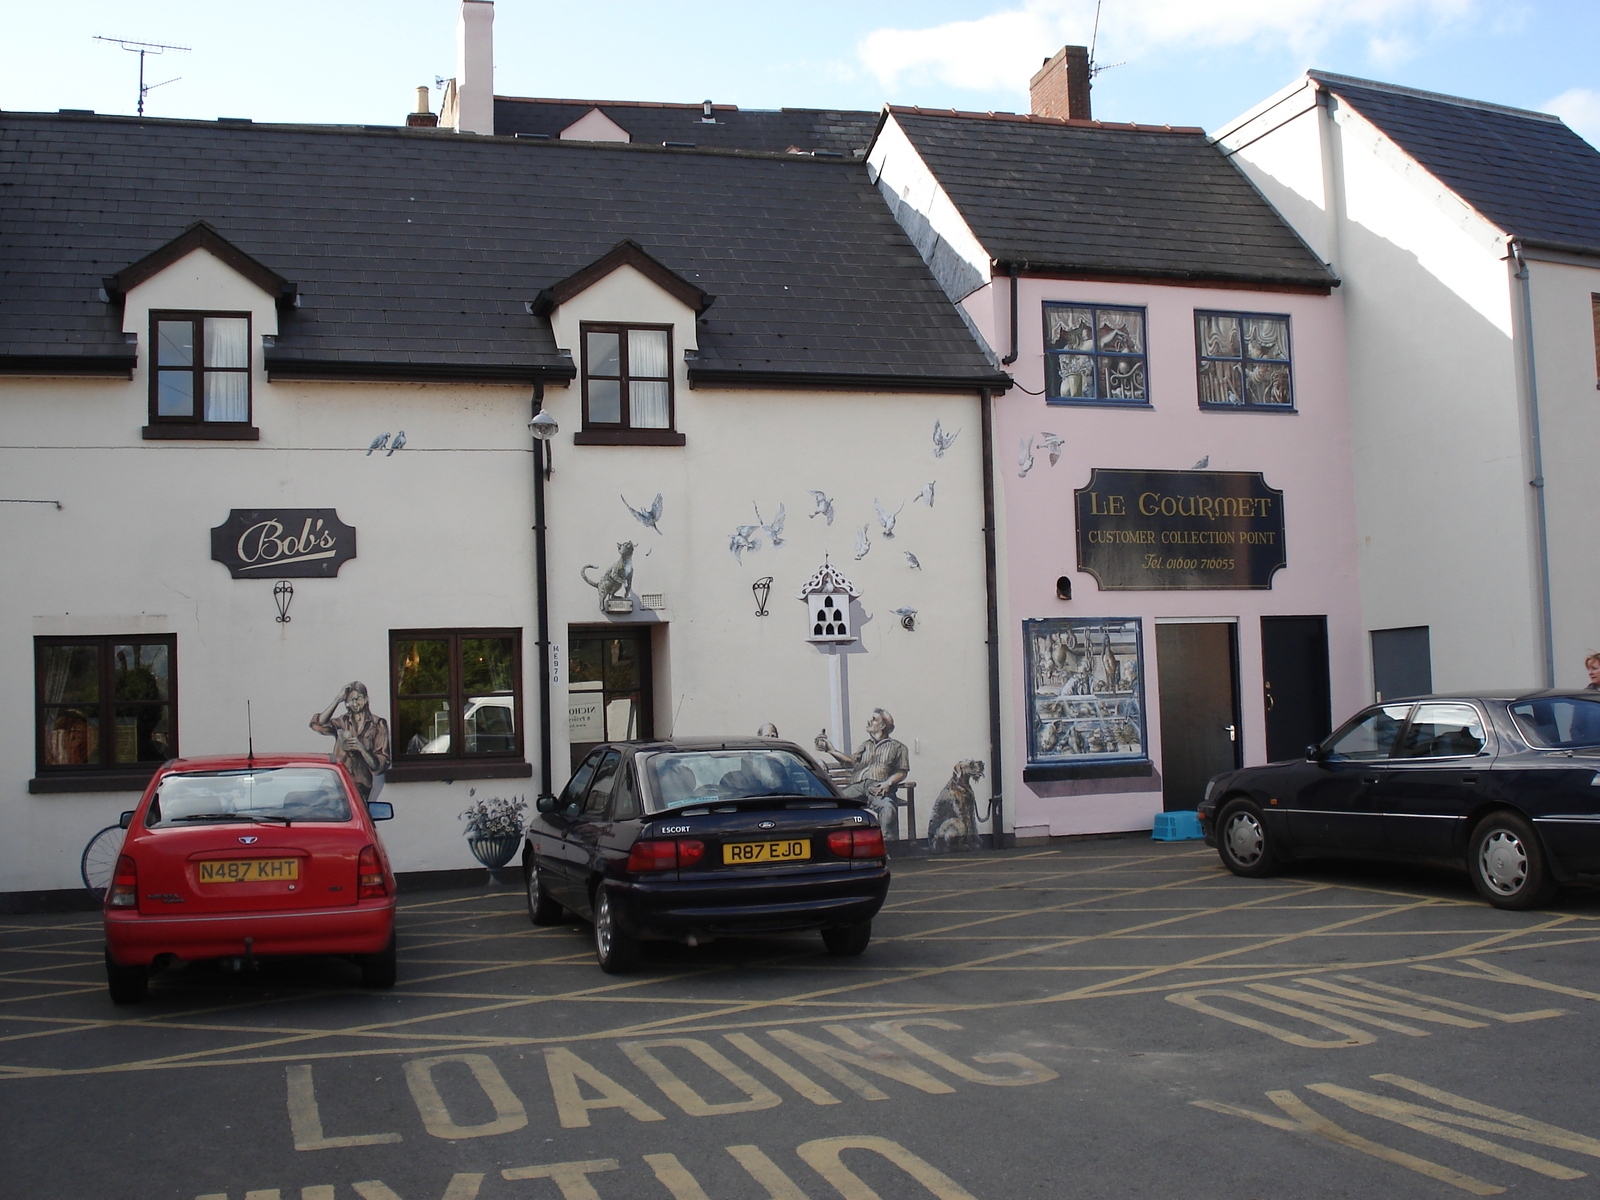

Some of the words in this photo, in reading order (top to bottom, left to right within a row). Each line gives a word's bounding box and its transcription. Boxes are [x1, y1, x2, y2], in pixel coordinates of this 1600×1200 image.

[1090, 492, 1126, 516] LE
[1138, 492, 1272, 520] GOURMET
[237, 518, 337, 563] Bob's
[1088, 530, 1155, 544] CUSTOMER
[1161, 531, 1235, 544] COLLECTION
[1239, 531, 1275, 544] POINT
[1142, 553, 1164, 569] Tel.
[1166, 556, 1197, 569] 01600
[1200, 558, 1235, 570] 716655
[731, 846, 766, 861] R87
[201, 862, 252, 880] N487
[258, 860, 296, 877] KHT
[285, 1018, 1060, 1151] LOADING
[1164, 958, 1600, 1048] ONLY
